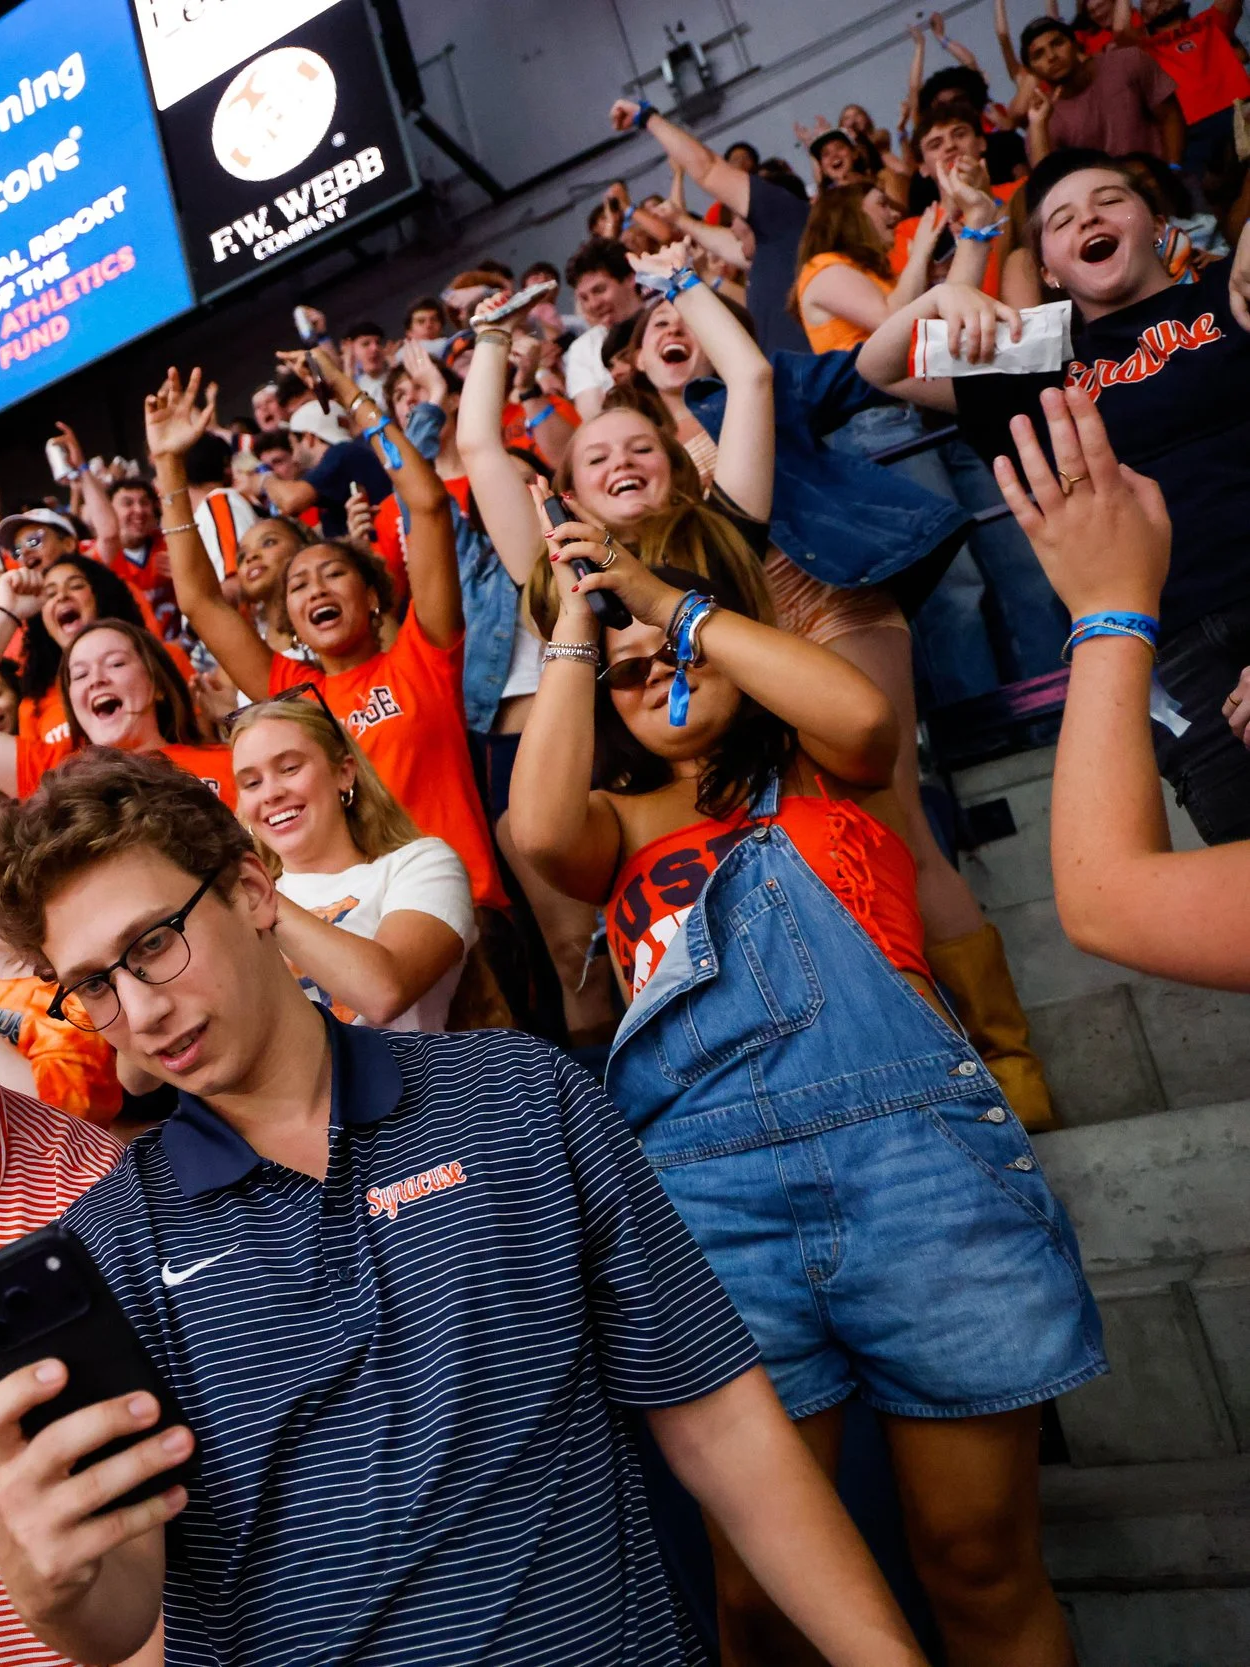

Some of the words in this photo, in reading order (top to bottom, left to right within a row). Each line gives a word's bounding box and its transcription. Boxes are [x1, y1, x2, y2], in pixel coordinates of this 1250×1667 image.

[274, 146, 385, 223] WEBB
[28, 185, 127, 262] RESORT
[252, 197, 347, 260] COMPANY
[0, 245, 136, 340] ATHLETICS
[16, 251, 70, 296] THE
[366, 1161, 468, 1219] Syracuse
